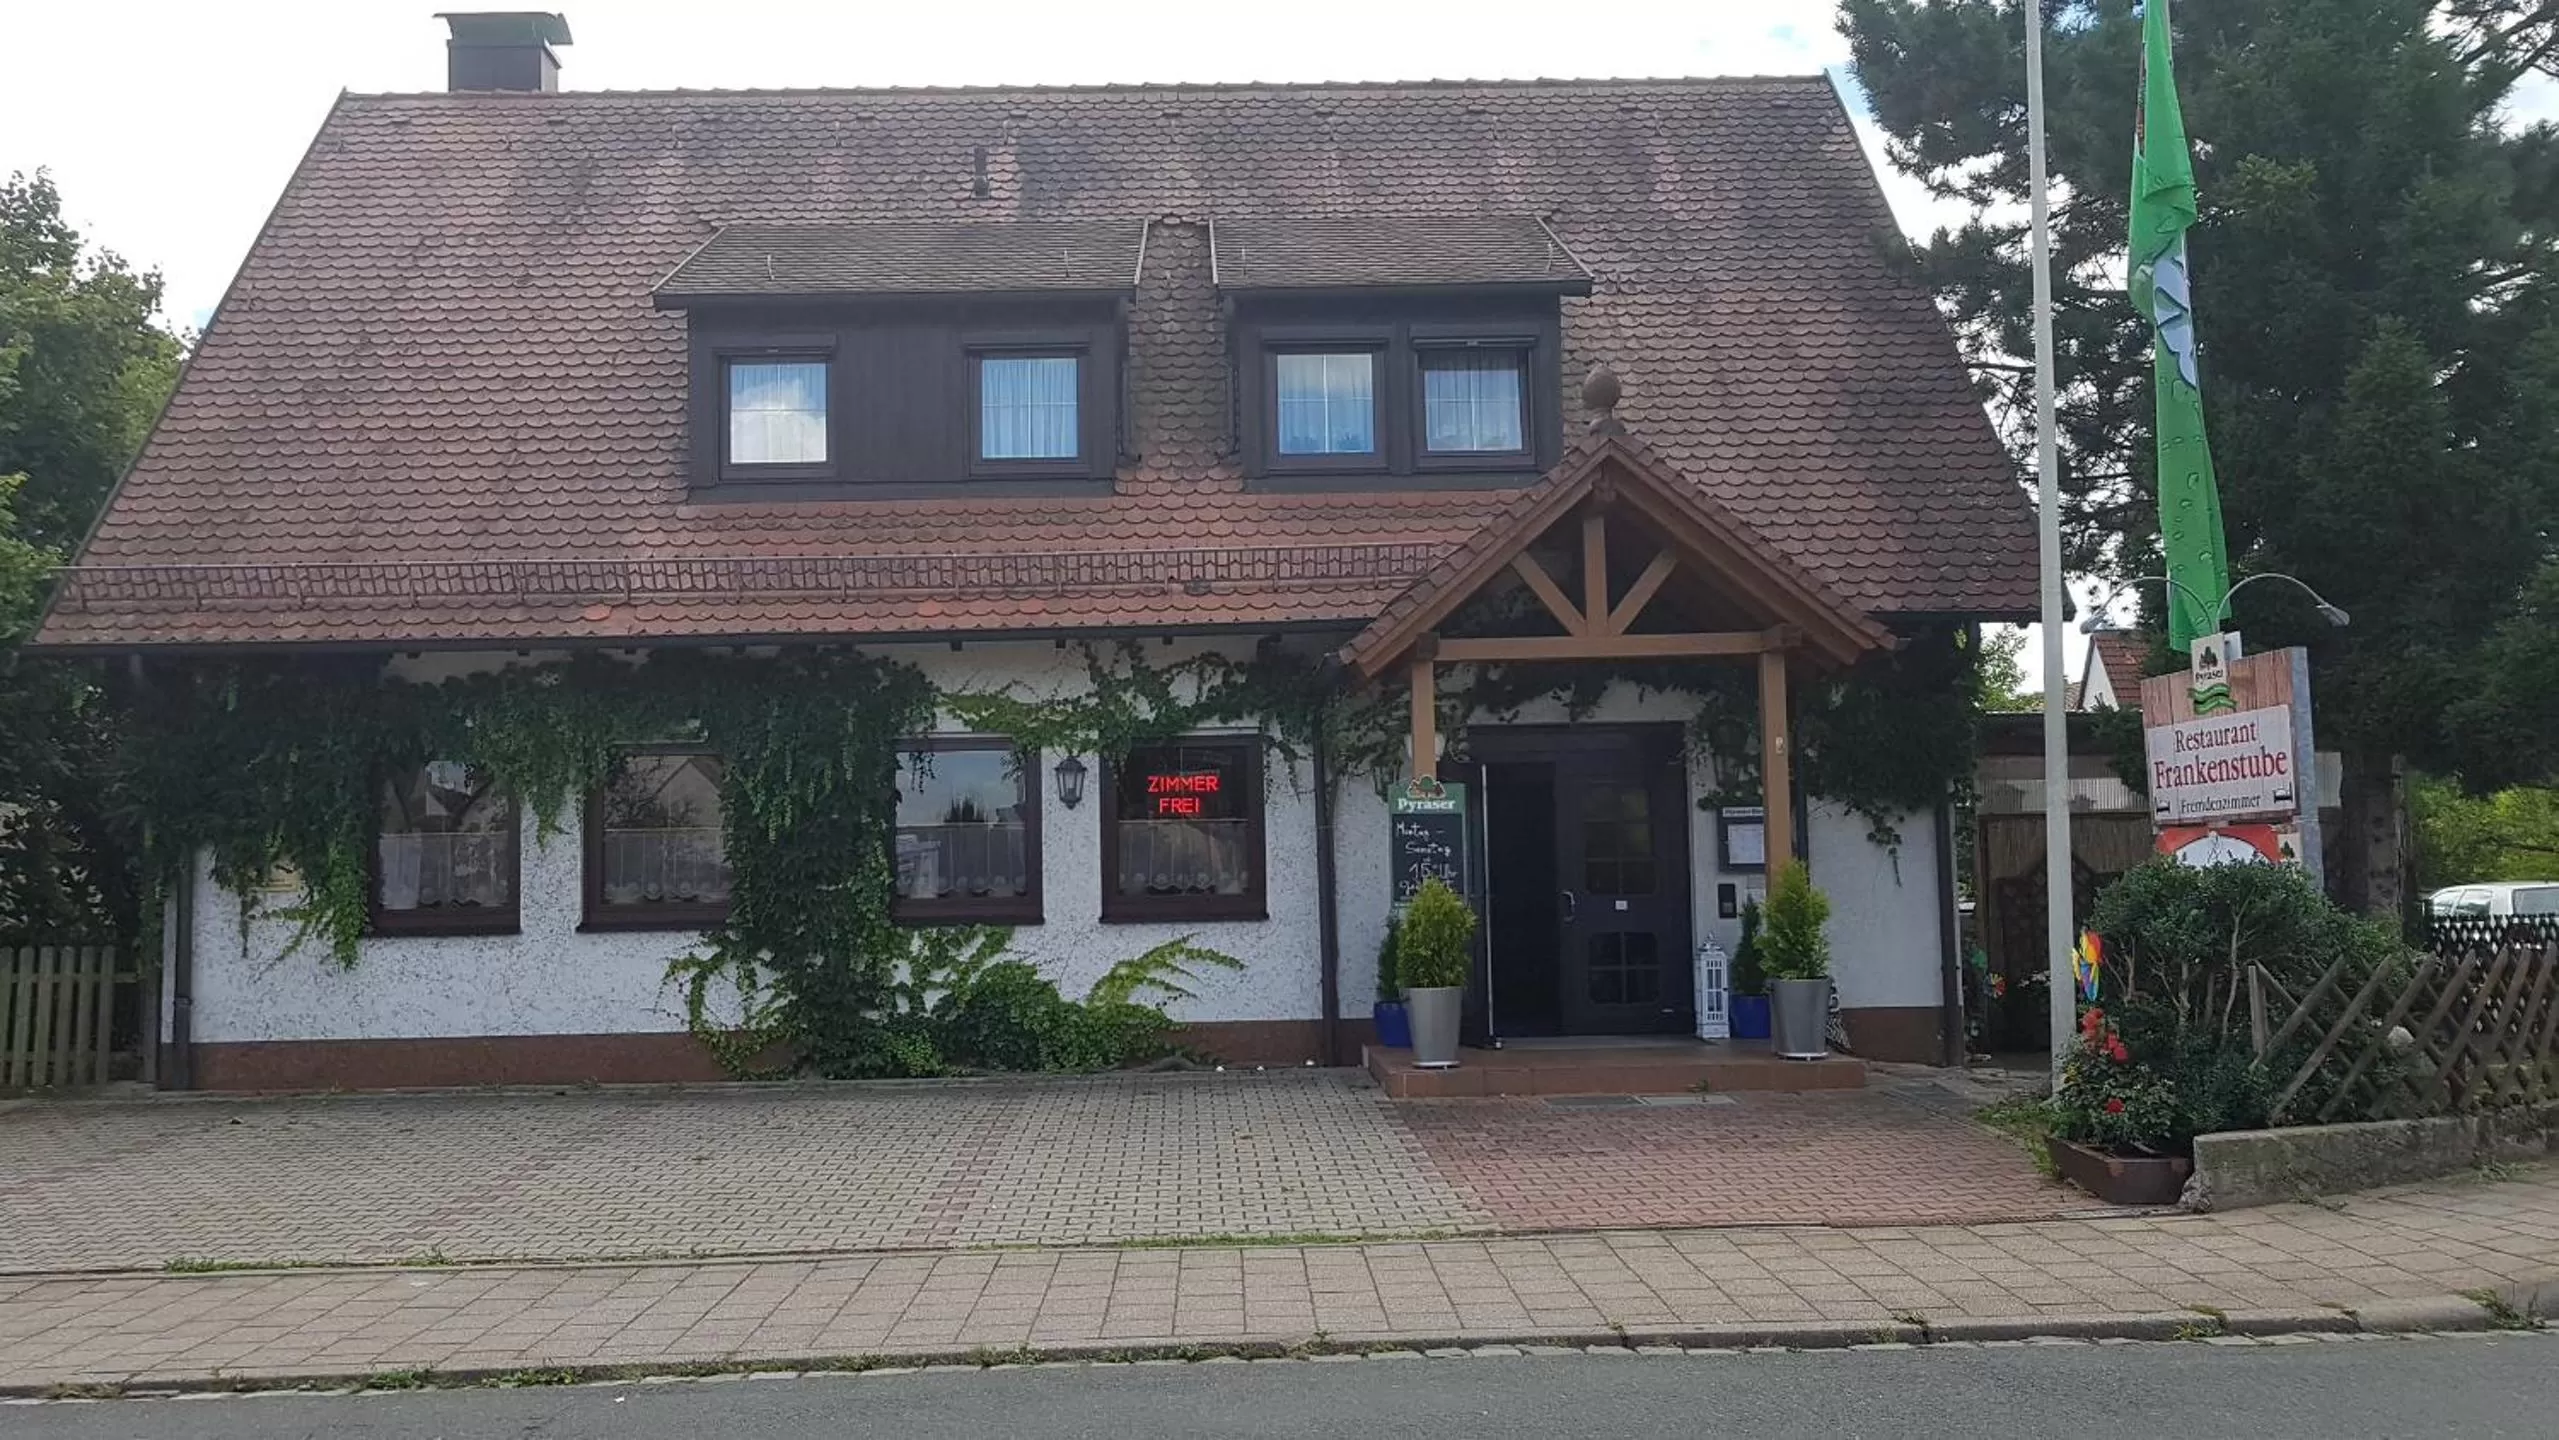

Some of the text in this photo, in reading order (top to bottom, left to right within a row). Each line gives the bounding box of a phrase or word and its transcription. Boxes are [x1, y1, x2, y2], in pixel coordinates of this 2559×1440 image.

[2174, 720, 2258, 753] Restaurant
[2154, 746, 2288, 789] Frankenstube
[1147, 775, 1219, 793] ZIMMER
[1159, 797, 1200, 813] FREI
[1397, 798, 1457, 813] Pyraser
[2180, 795, 2262, 815] Fremdenzimmer
